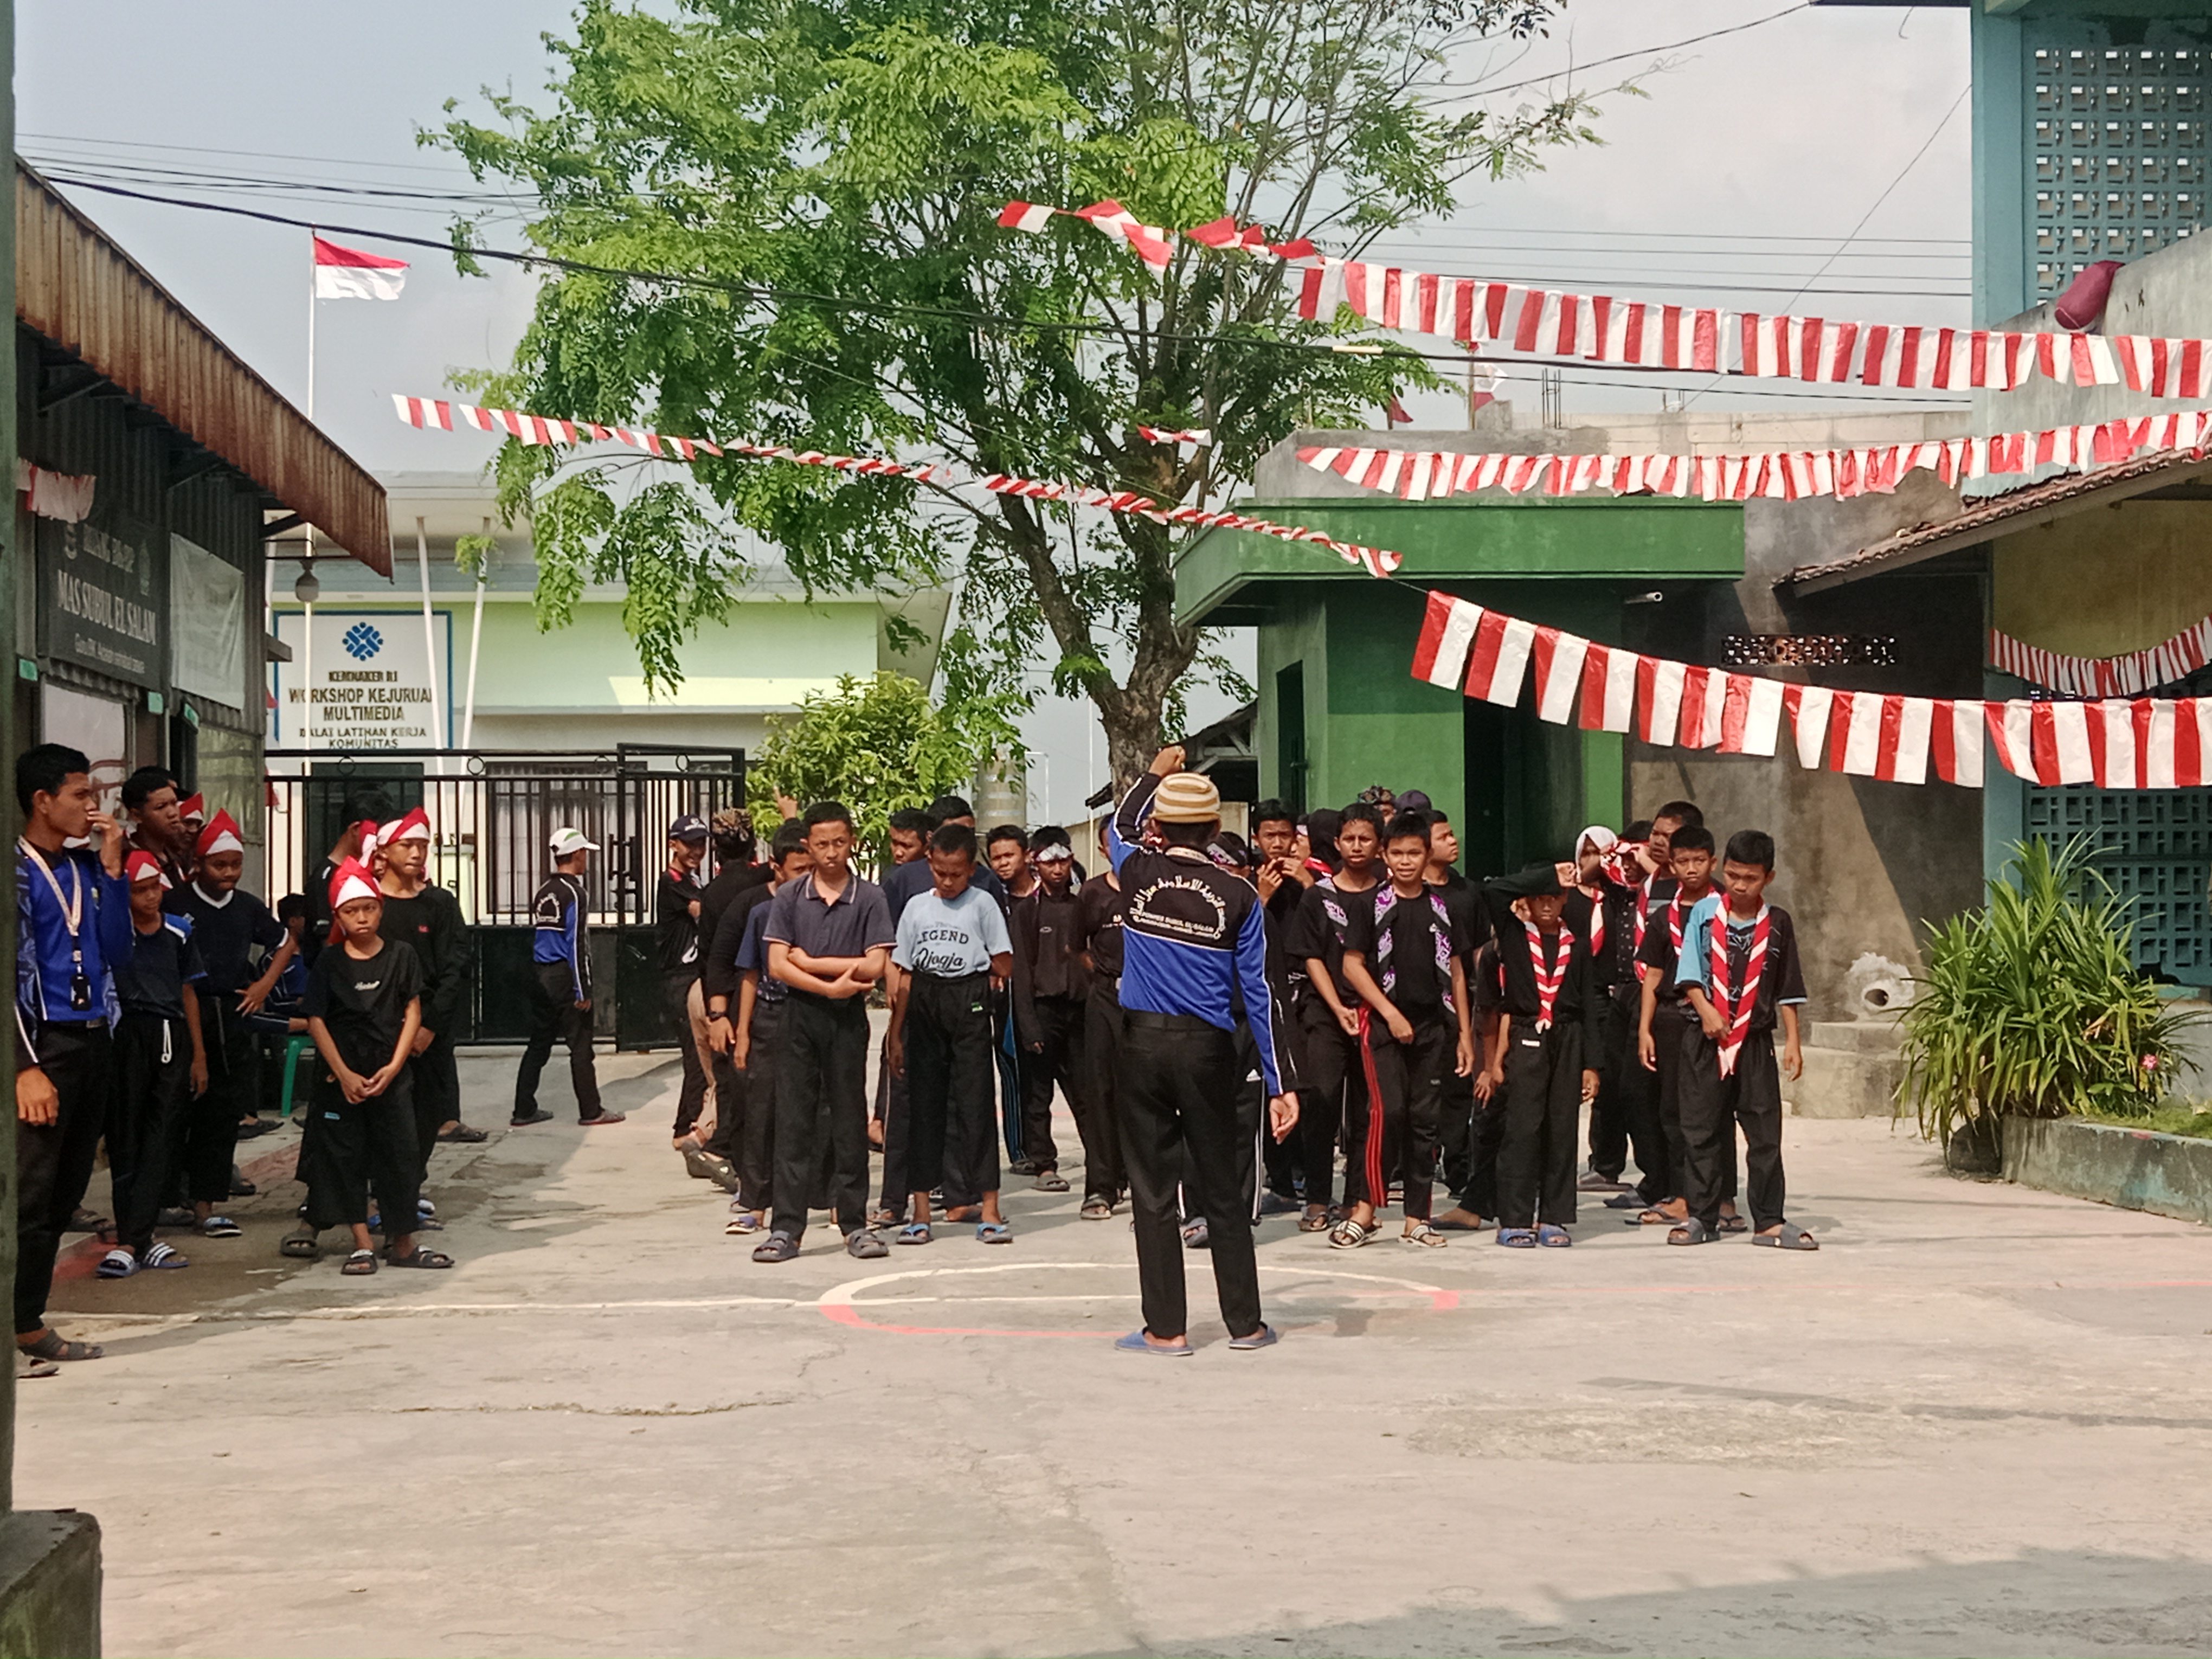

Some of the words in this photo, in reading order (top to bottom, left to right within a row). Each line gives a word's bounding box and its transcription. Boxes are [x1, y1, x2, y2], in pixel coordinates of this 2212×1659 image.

[368, 687, 433, 703] KEJURUA
[324, 705, 405, 722] MULTIMEDIA
[337, 728, 388, 737] LATIHAN
[391, 728, 427, 737] KERJA
[328, 738, 399, 749] KOMUNITAS
